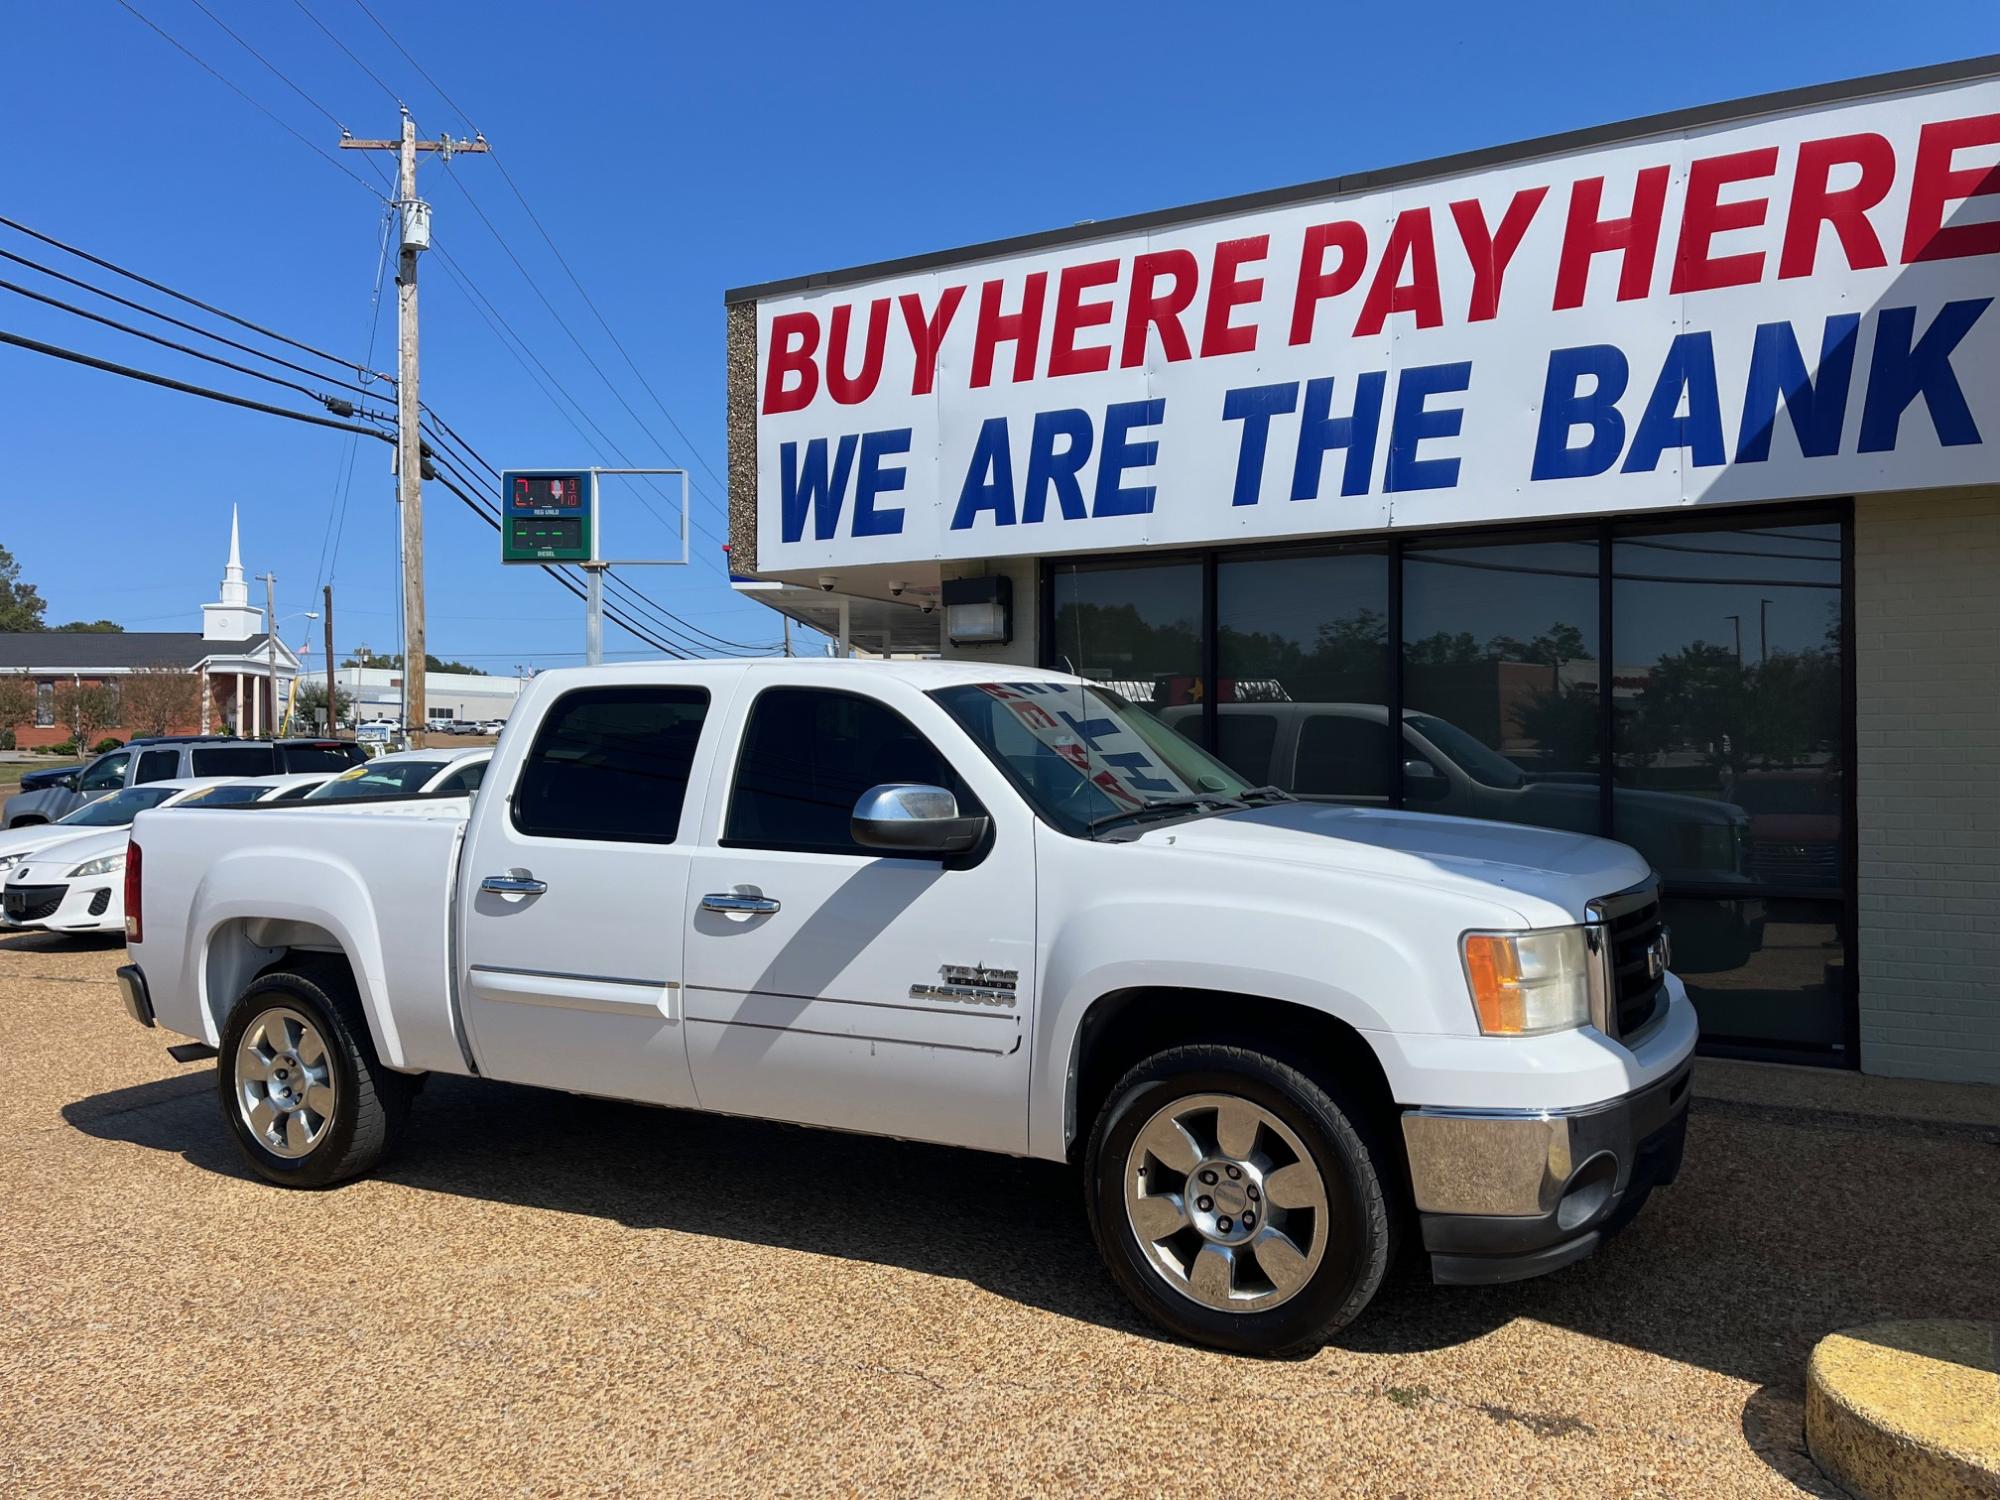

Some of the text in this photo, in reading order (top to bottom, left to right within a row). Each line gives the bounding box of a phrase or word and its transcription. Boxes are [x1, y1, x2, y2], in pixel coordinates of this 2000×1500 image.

[763, 113, 2000, 415] BUY HERE PAY HERE
[780, 296, 1996, 544] WE ARE THE BANK
